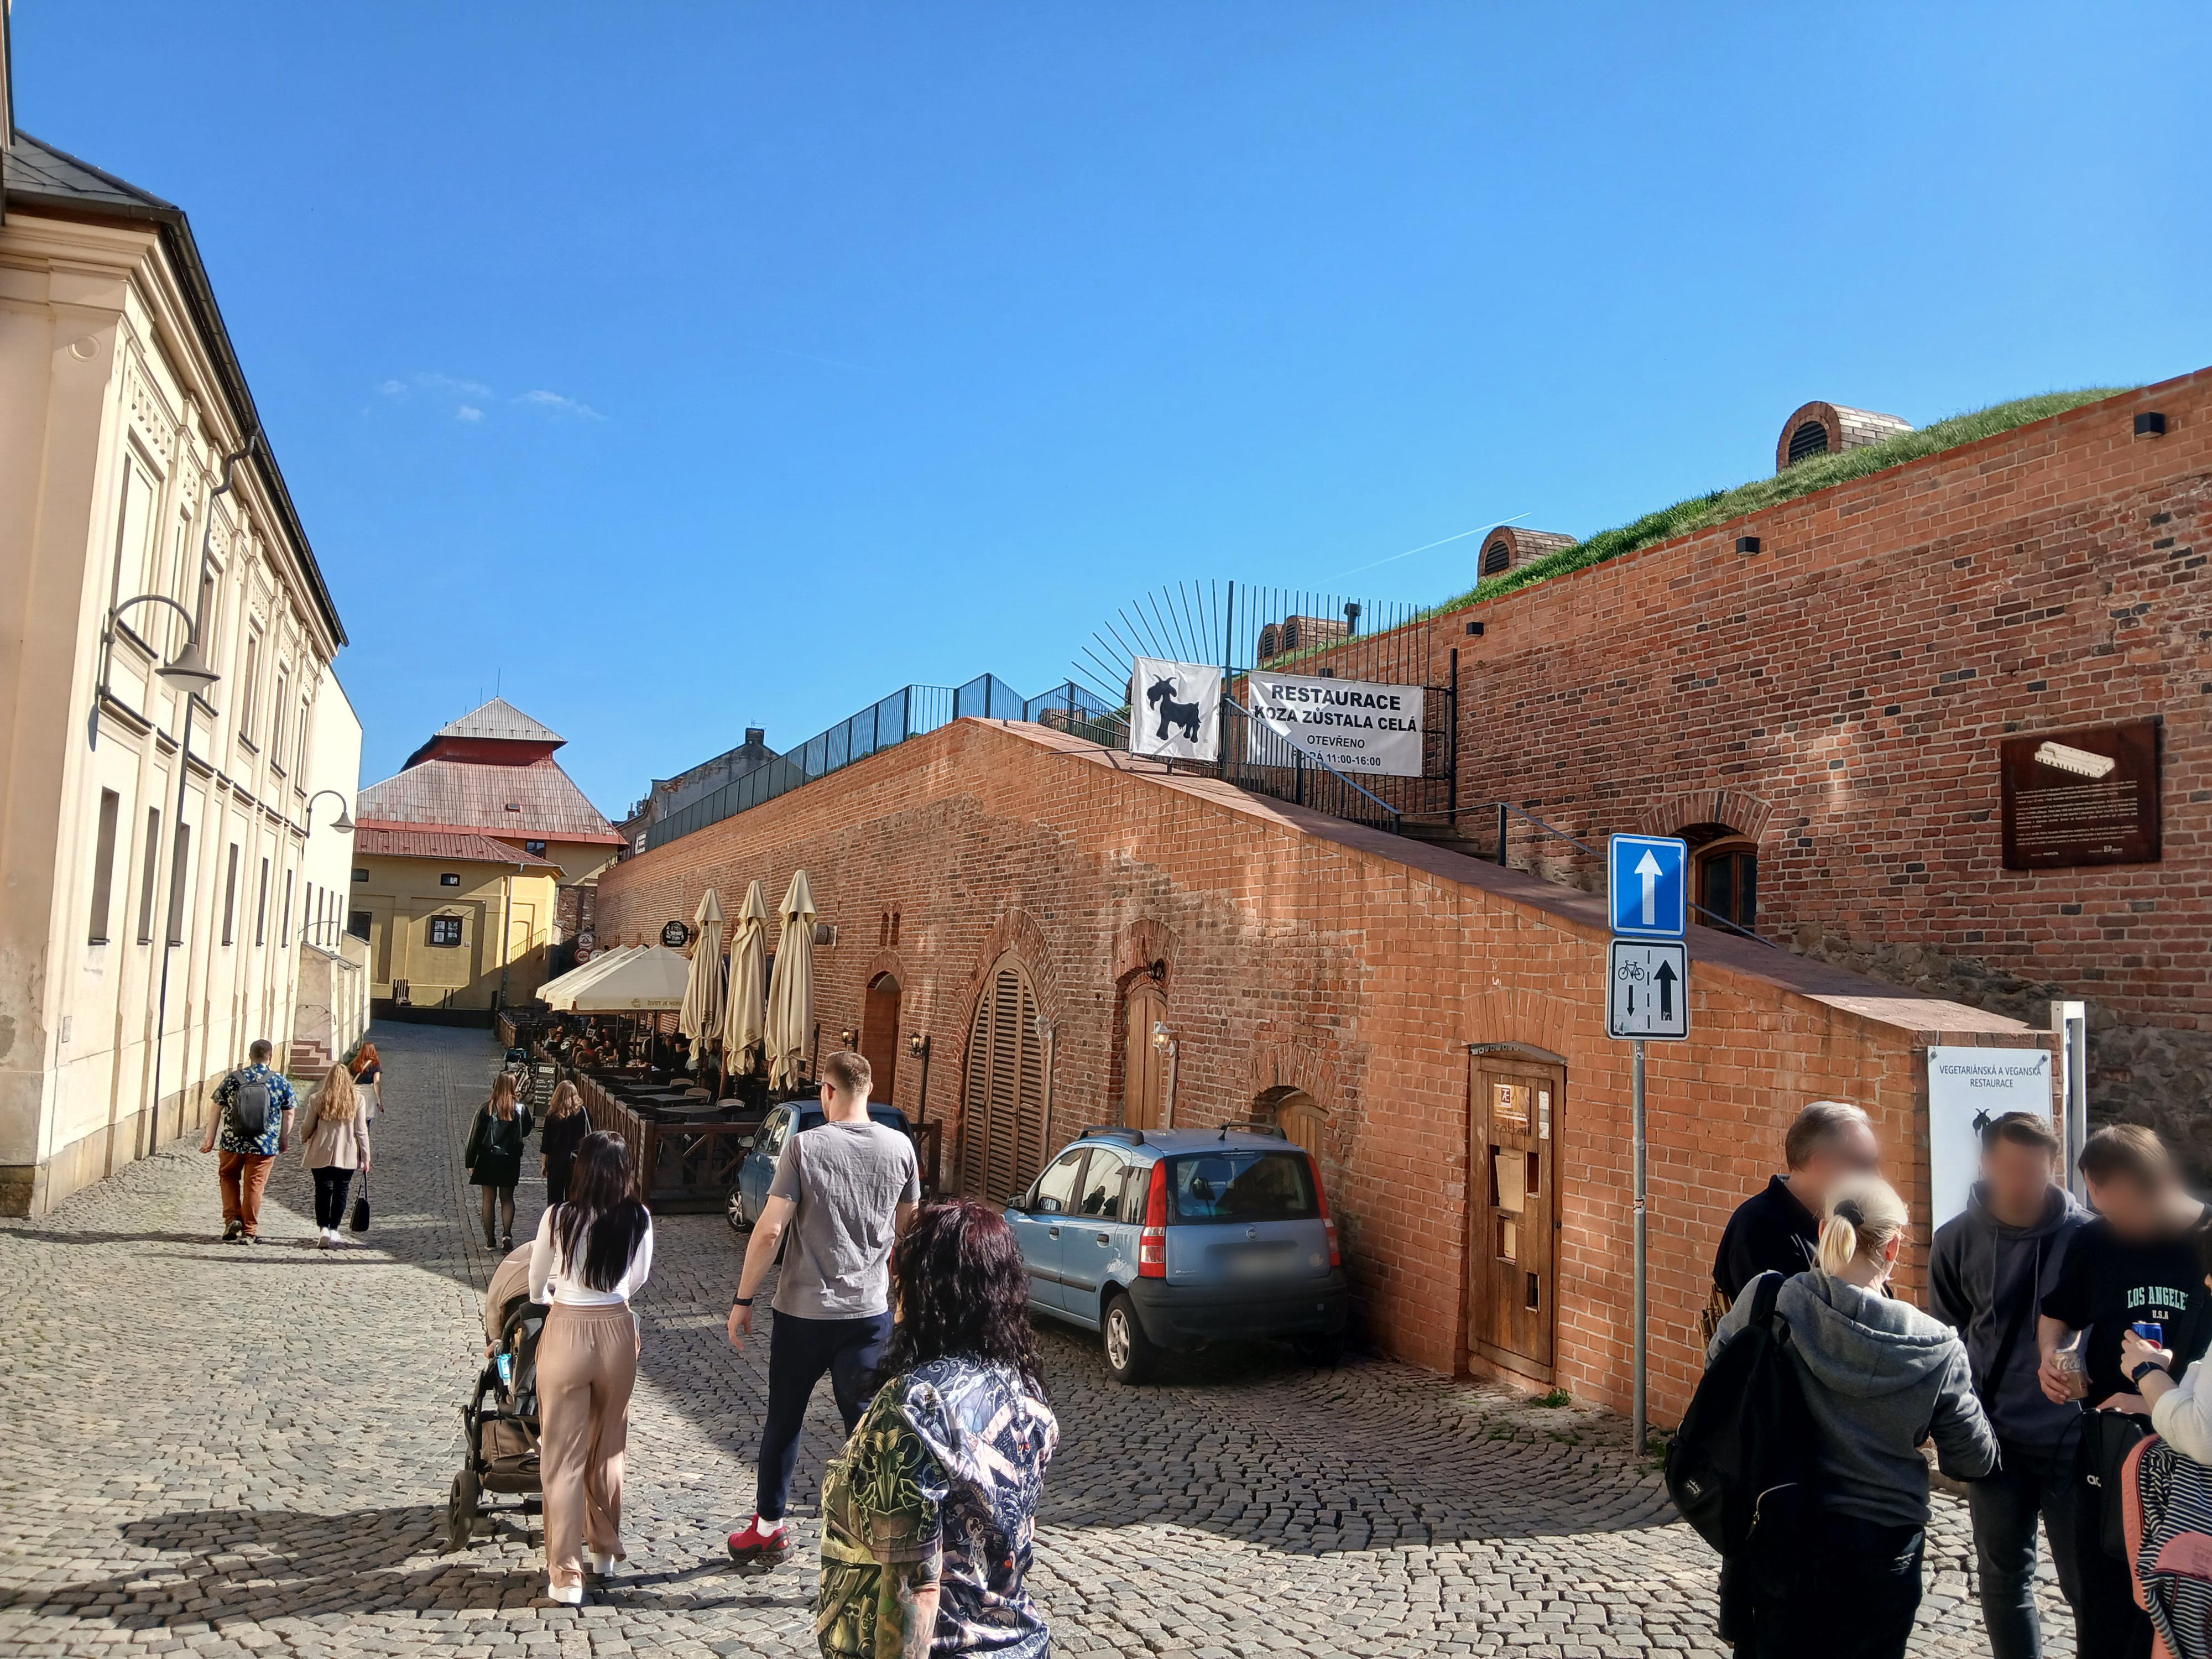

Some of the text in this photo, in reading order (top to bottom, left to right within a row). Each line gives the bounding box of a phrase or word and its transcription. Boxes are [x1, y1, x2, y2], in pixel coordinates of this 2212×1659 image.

[1272, 685, 1401, 711] RESTAURACE
[1254, 705, 1417, 732] KOZA ZŮSTALA CELÁ
[1307, 734, 1365, 749] OTEVŘENO
[1326, 753, 1381, 767] 11:00-16:00
[1939, 1064, 1996, 1075] VEGETARIÁNSKÁ
[2005, 1066, 2041, 1076] VEGANSKÁ
[1970, 1078, 2013, 1088] RESTAURACE
[2127, 1286, 2188, 1311] LOS ANGELE
[2152, 1310, 2169, 1320] U.S.A
